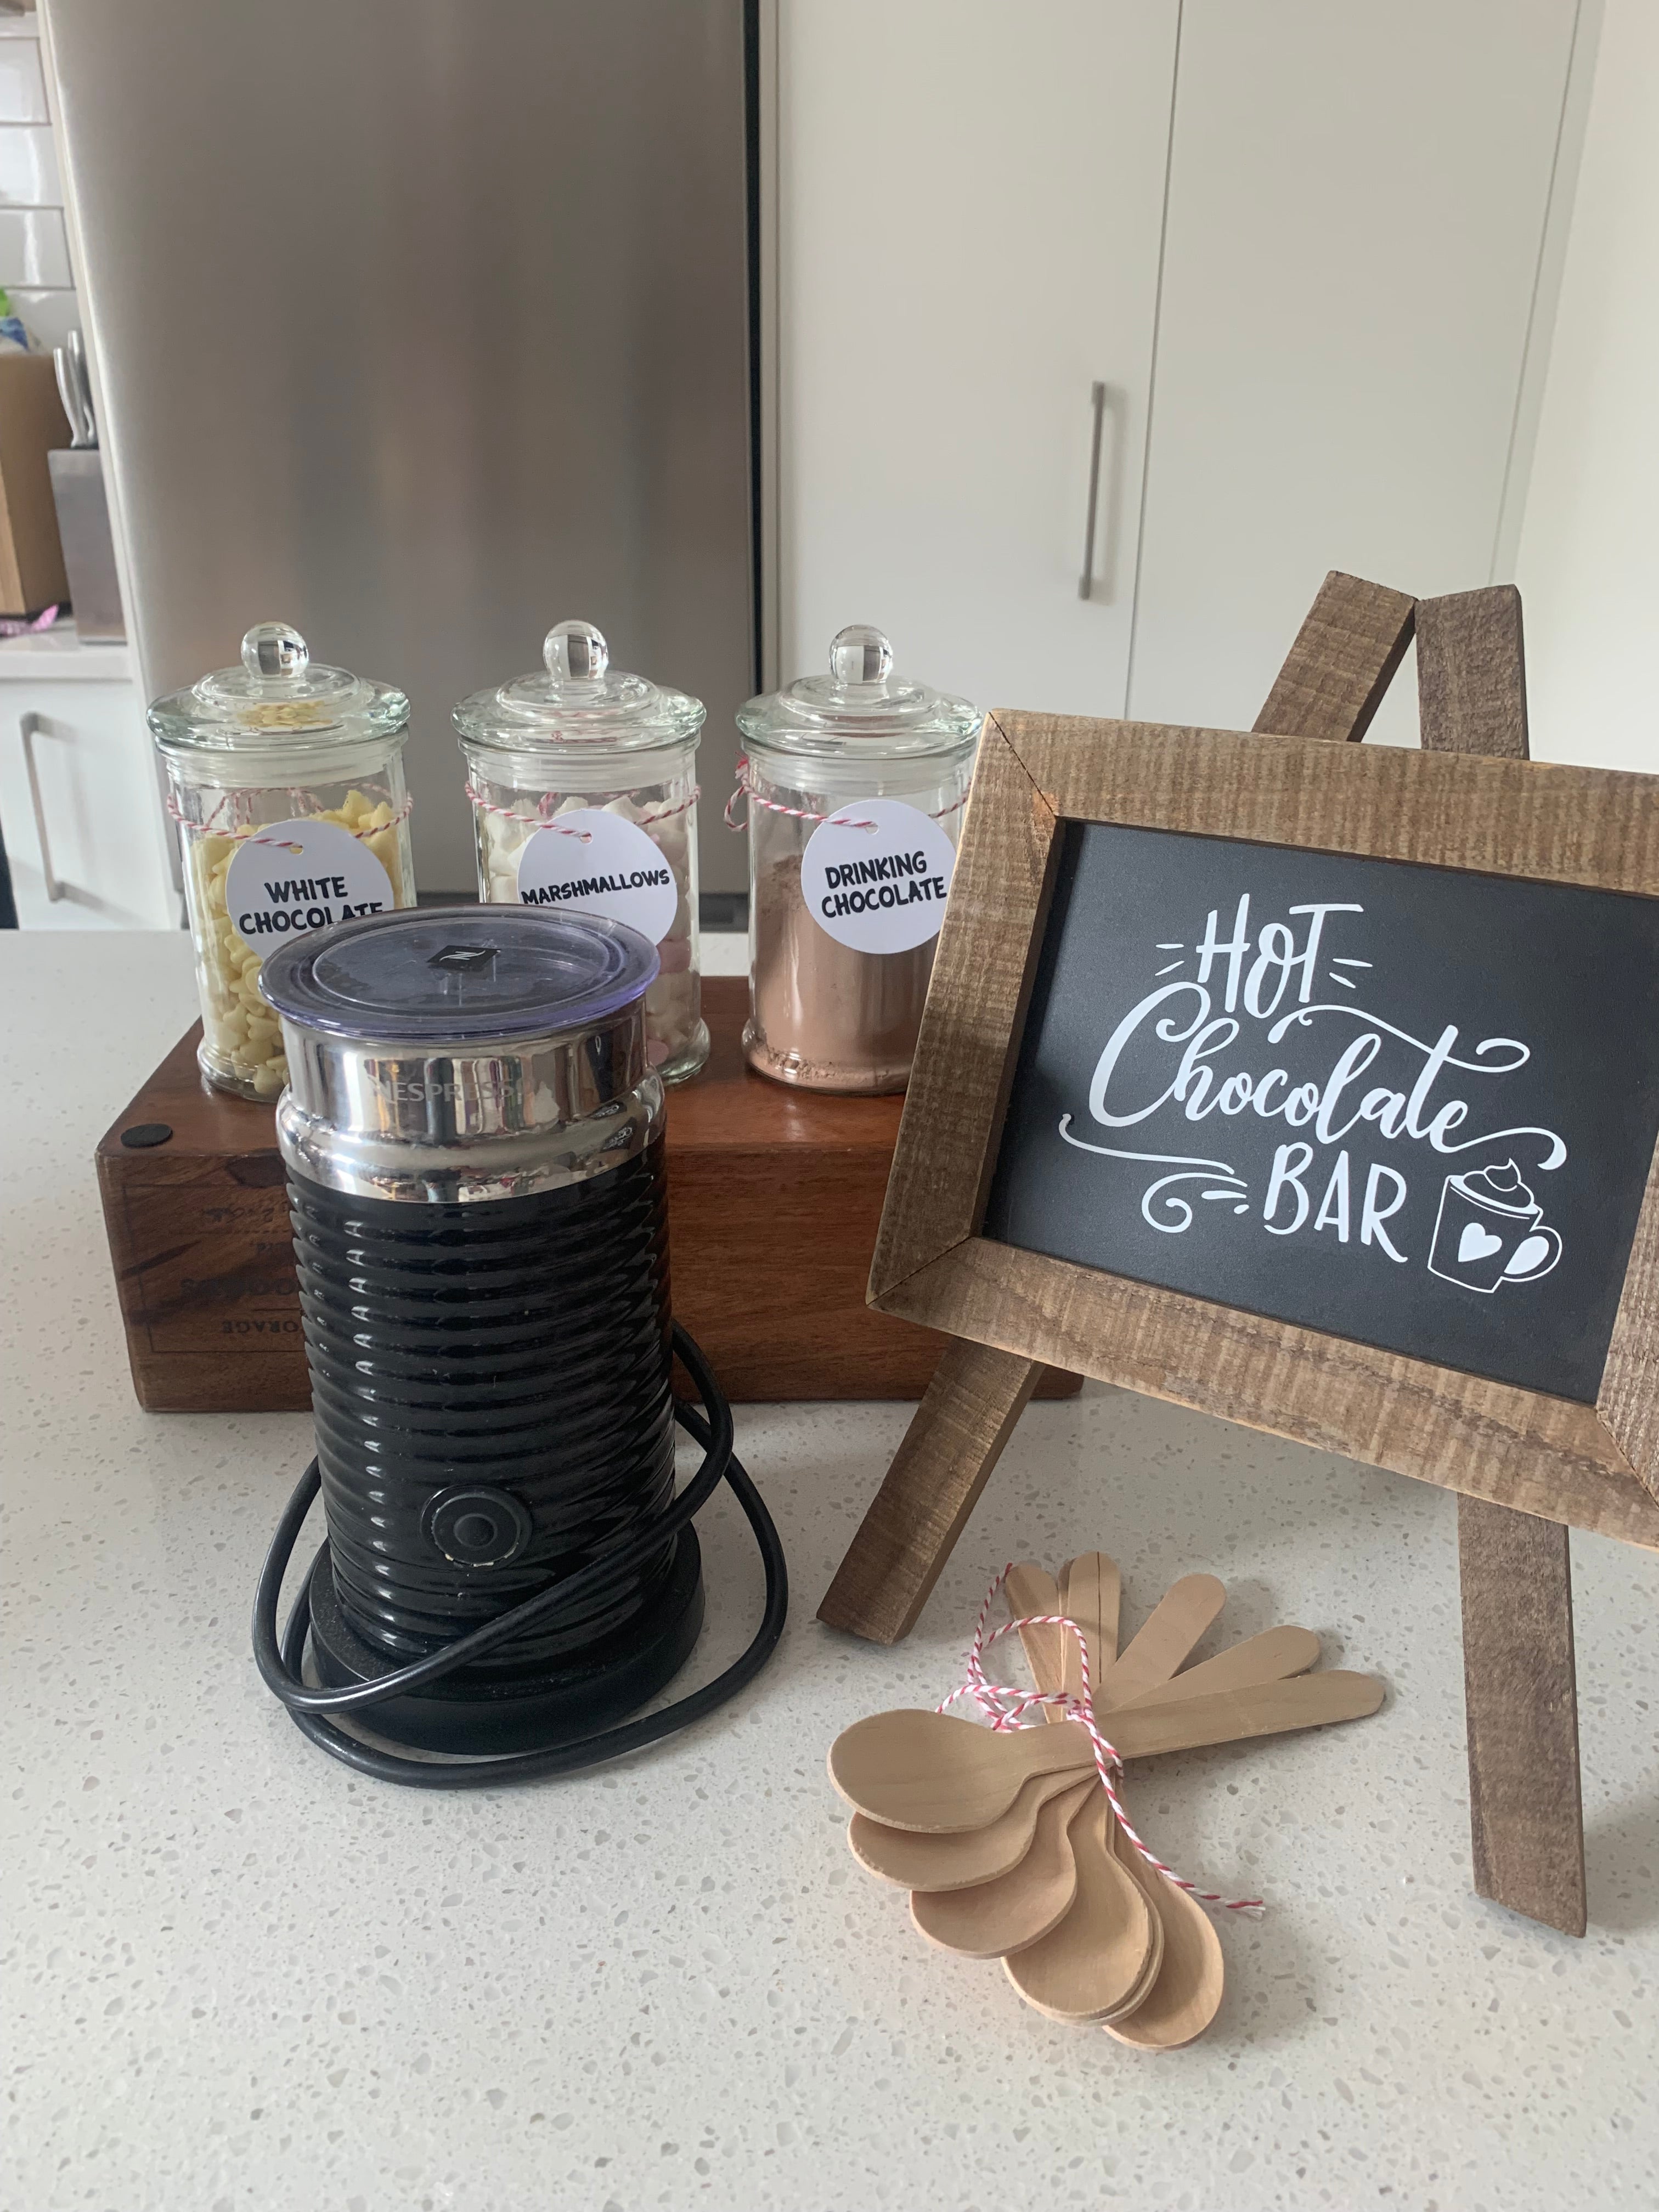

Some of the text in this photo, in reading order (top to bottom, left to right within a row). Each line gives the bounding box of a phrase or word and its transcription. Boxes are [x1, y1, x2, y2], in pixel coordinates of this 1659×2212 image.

[264, 876, 348, 903] WHITE
[521, 869, 669, 905] MARSHMALLOWS
[825, 851, 927, 889] DRINKING
[821, 876, 947, 918] CHOCOLATE
[1196, 893, 1364, 1018] HOT
[1089, 981, 1567, 1170] Chocolate
[1263, 1141, 1408, 1263] BAR
[222, 1321, 299, 1334] ORAGE
